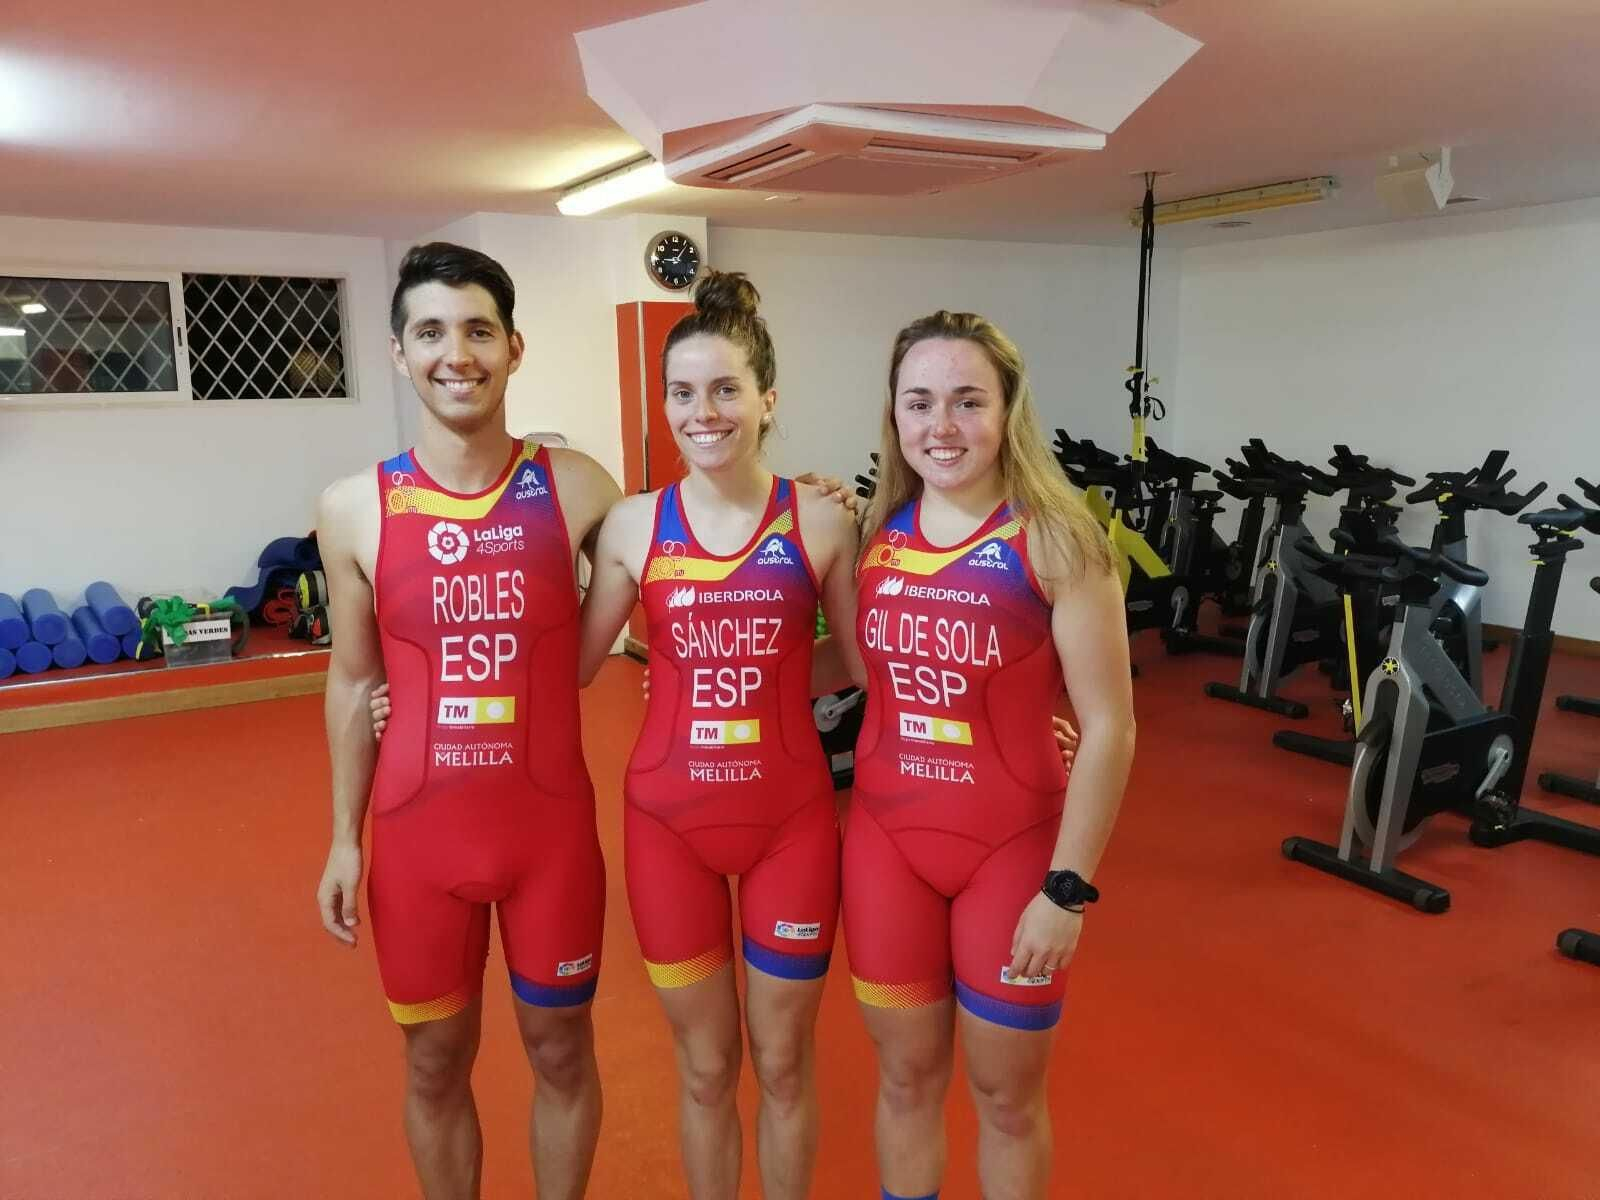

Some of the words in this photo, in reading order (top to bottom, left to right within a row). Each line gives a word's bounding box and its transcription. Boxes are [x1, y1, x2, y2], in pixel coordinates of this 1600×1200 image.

[673, 277, 679, 285] 6
[474, 525, 523, 542] LaLiga
[476, 541, 525, 555] 4Sports
[433, 570, 525, 624] ROBLES
[699, 589, 784, 604] IBERDROLA
[904, 584, 991, 606] IBERDROLA
[671, 611, 783, 659] SÁNCHEZ
[865, 608, 893, 652] GIL
[899, 612, 930, 657] DE
[935, 617, 1003, 668] SOLA
[440, 633, 518, 682] ESP
[692, 666, 762, 708] ESP
[887, 661, 968, 708] ESP
[444, 704, 469, 719] TM
[695, 727, 719, 740] TM
[903, 719, 927, 735] TM
[433, 743, 463, 751] CIUDAD
[434, 750, 513, 767] MELILLA
[688, 760, 715, 768] CIUDAD
[898, 752, 926, 763] CIUDAD
[689, 767, 762, 782] MELILLA
[899, 760, 975, 785] MELILLA
